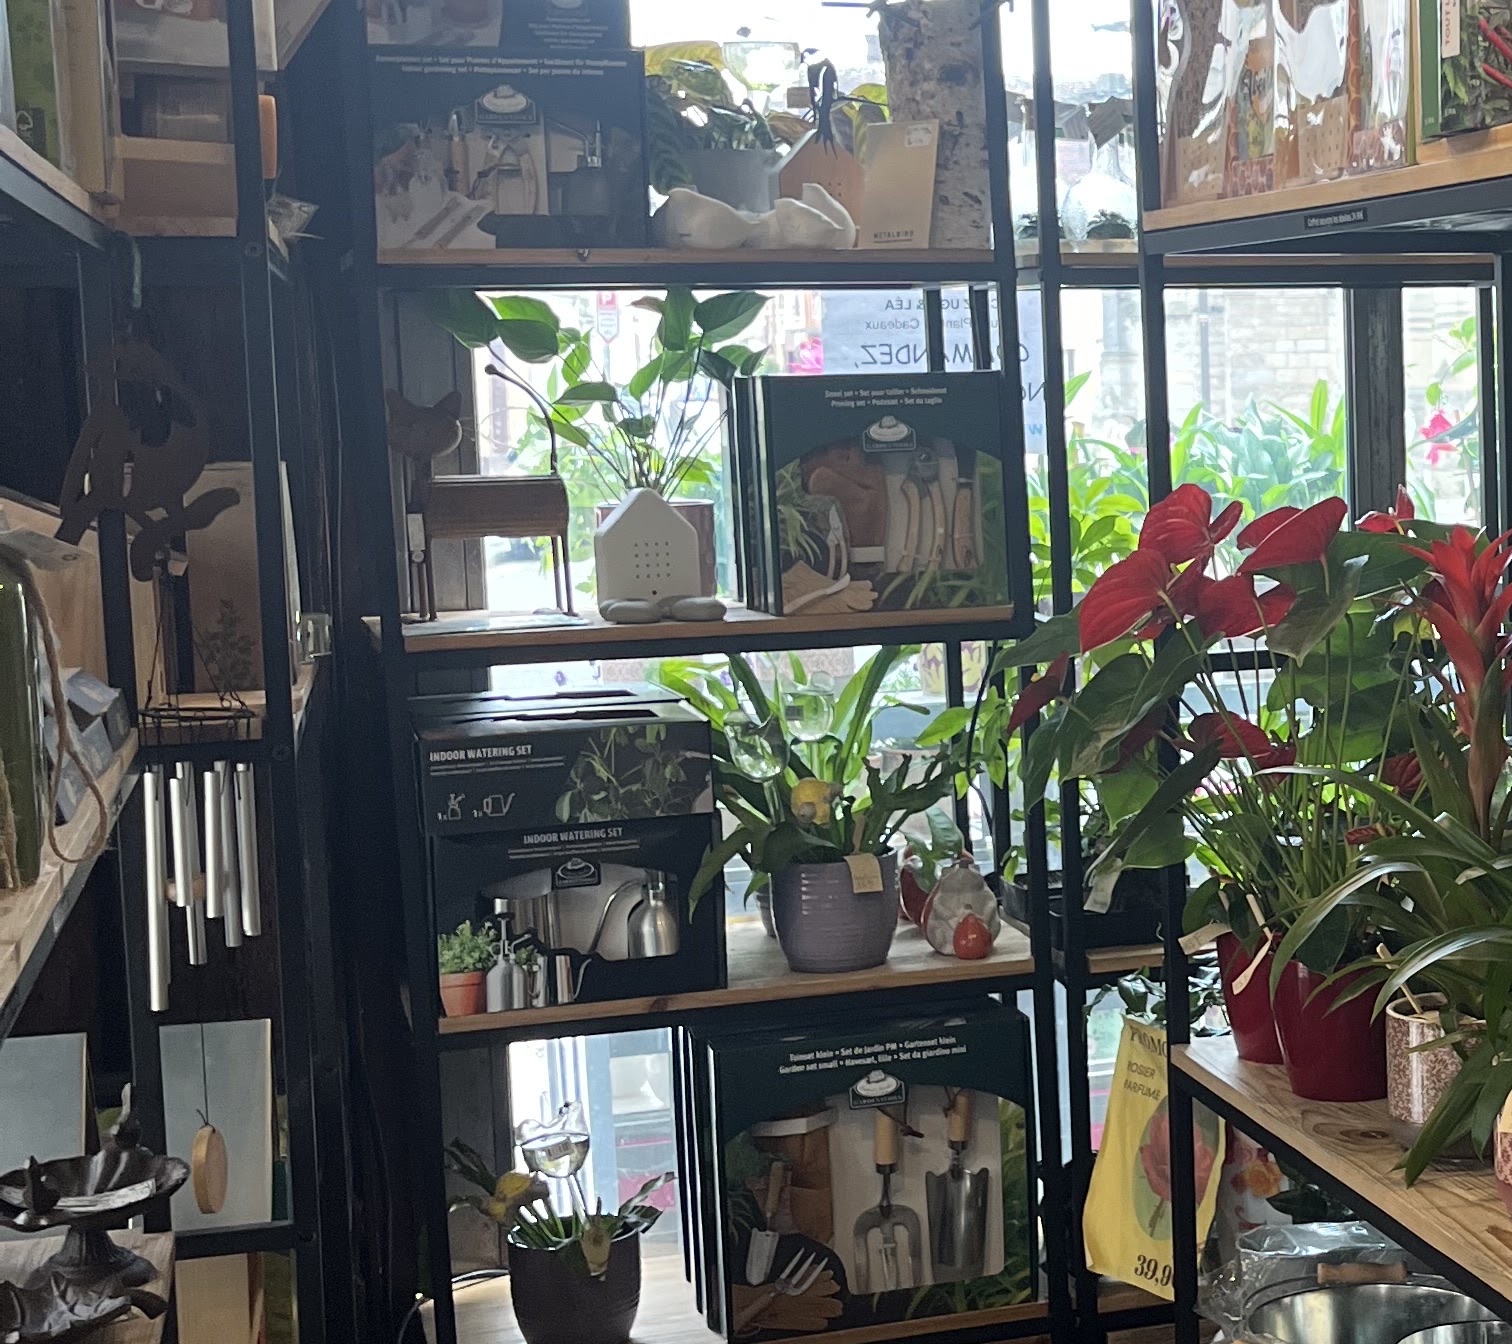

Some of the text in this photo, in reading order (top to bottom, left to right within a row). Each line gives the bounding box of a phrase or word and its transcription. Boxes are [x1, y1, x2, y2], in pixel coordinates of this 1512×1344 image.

[831, 400, 855, 408] Pruning
[924, 397, 943, 405] taglio
[429, 744, 533, 762] INDOOR WATERING SET
[523, 827, 624, 845] INDOOR WATERING SET
[815, 1050, 834, 1059] klein
[840, 1047, 852, 1056] Set
[853, 1047, 863, 1055] de
[863, 1044, 885, 1054] jardin
[885, 1042, 897, 1050] PM
[904, 1038, 938, 1049] Gartenset
[938, 1036, 957, 1045] klein
[779, 1064, 806, 1075] Garden
[806, 1063, 817, 1071] set
[818, 1060, 839, 1069] small
[898, 1052, 912, 1061] Set
[911, 1050, 922, 1059] da
[922, 1047, 951, 1059] giardino
[951, 1045, 967, 1055] mini
